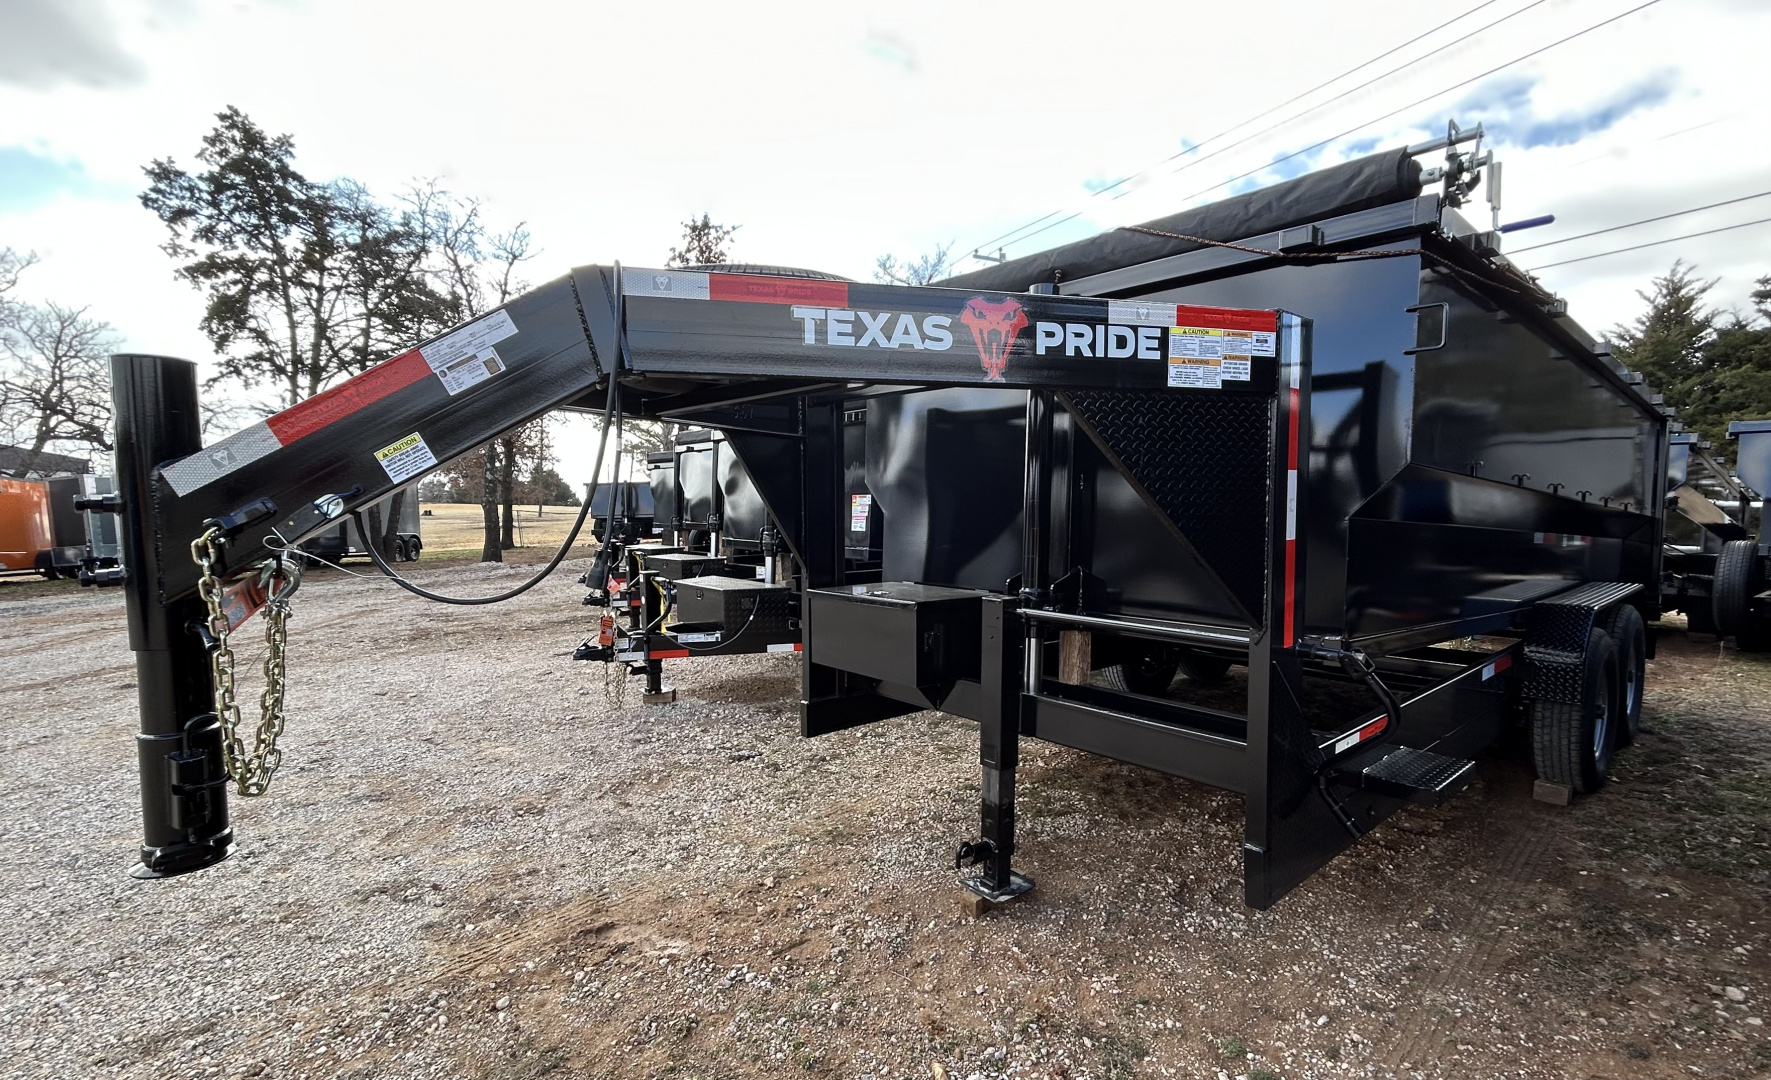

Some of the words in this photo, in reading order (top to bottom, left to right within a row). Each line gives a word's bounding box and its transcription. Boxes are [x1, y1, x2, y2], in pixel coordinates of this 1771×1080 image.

[793, 306, 953, 351] TEXAS
[1036, 321, 1160, 360] PRIDE
[386, 437, 417, 455] CAUTION
